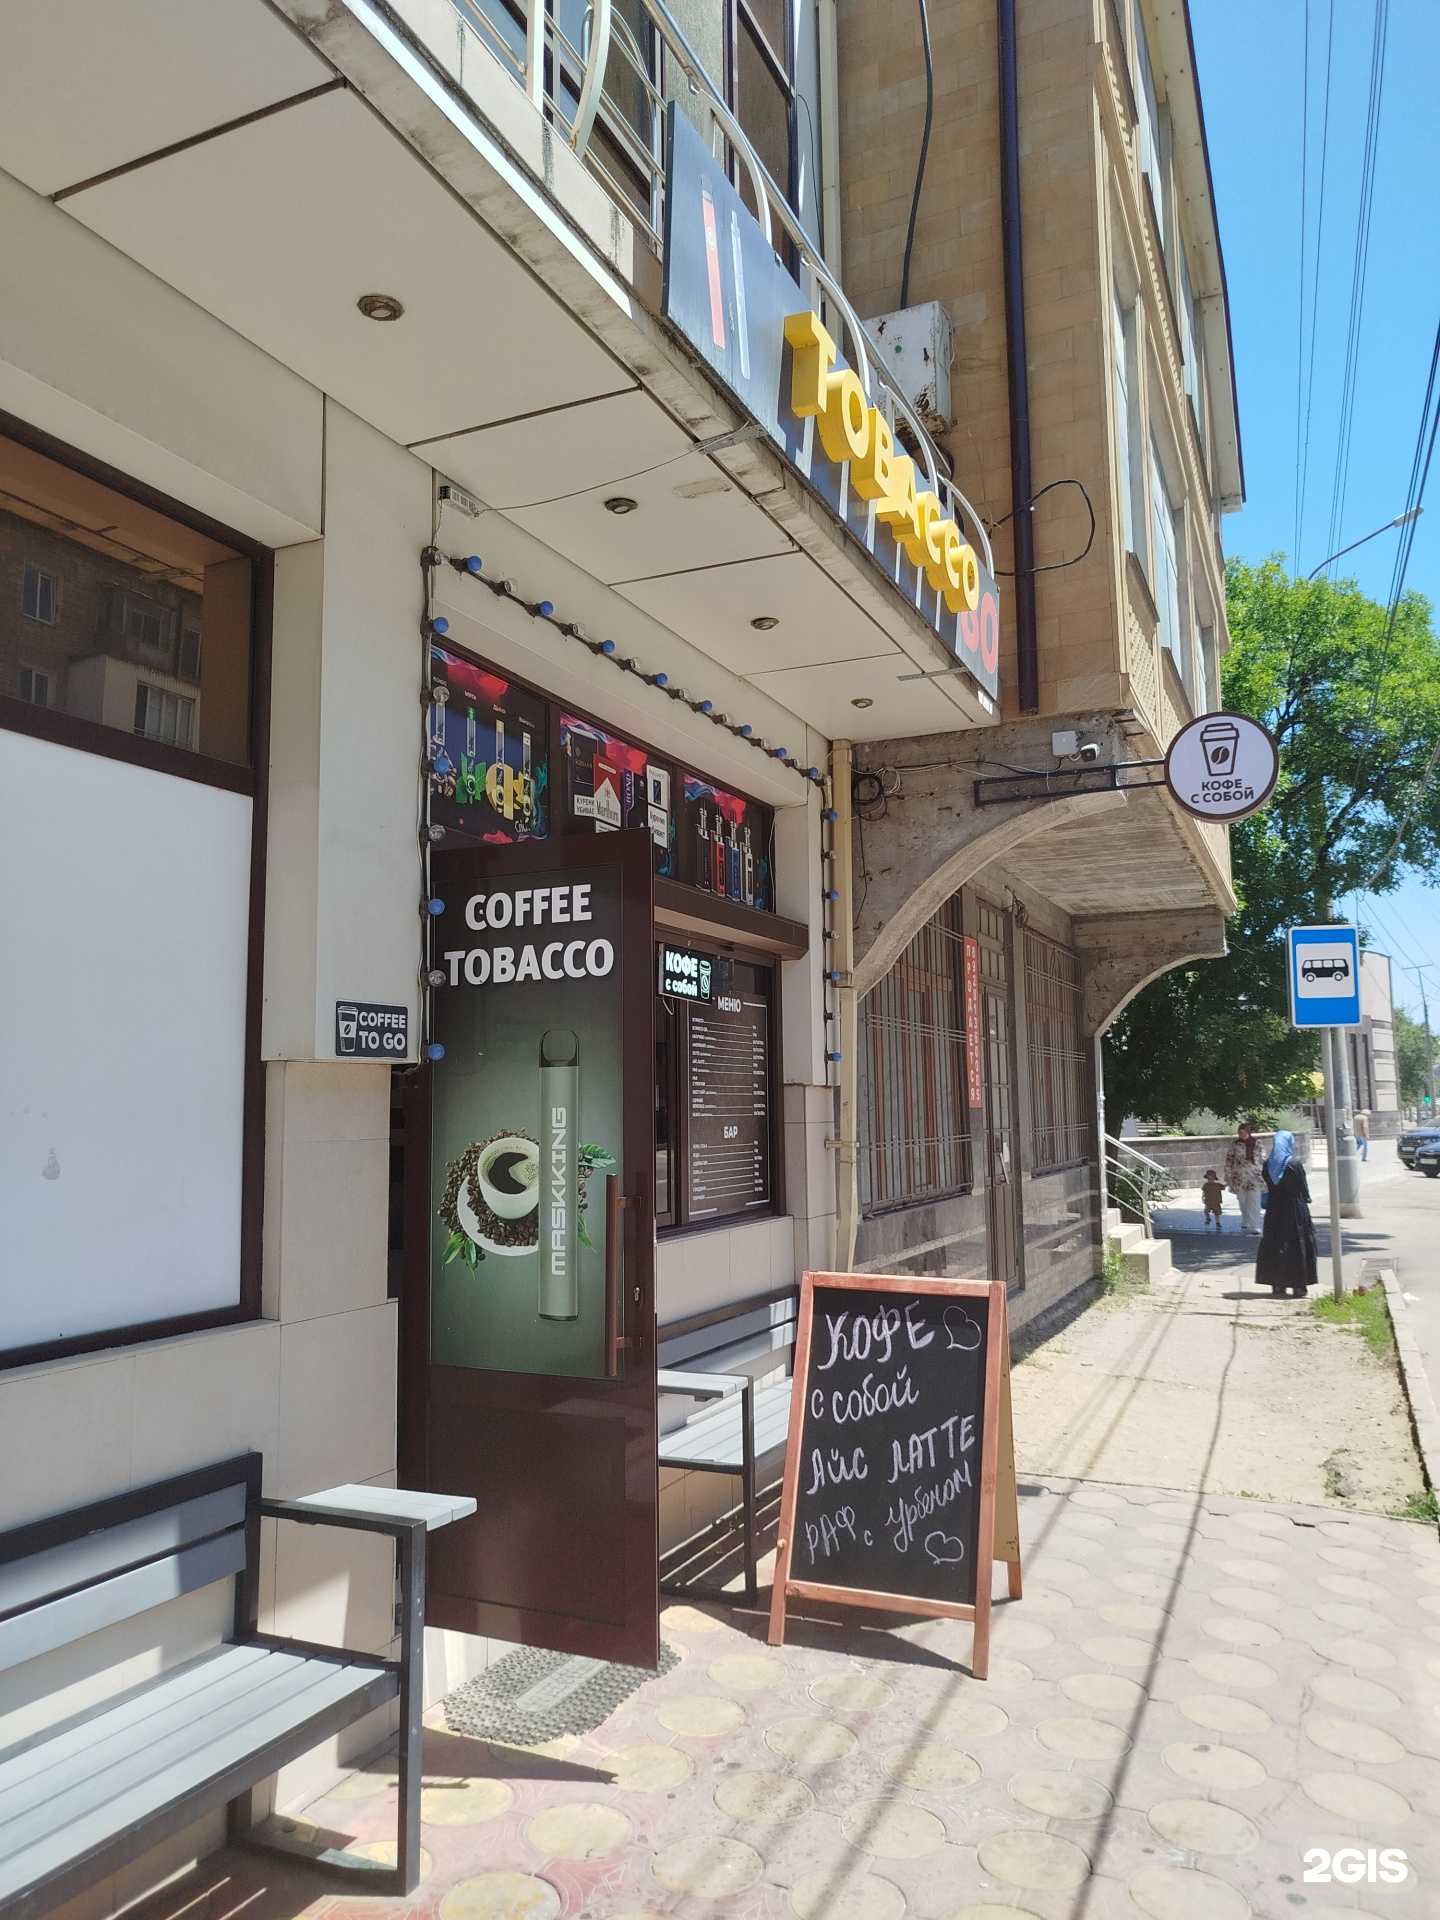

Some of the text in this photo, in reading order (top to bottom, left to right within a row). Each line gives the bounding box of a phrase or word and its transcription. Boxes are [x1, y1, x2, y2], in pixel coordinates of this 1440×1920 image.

[784, 311, 979, 614] TOBACCO
[625, 772, 633, 804] BOND
[1190, 786, 1254, 804] С СОБОЙ
[1201, 779, 1243, 792] КОФЕ
[465, 883, 592, 931] COFFEE
[444, 938, 615, 987] TOBACCO
[665, 951, 699, 978] КОФЕ
[665, 978, 698, 997] с собой
[717, 996, 742, 1014] МЕНЮ
[358, 1011, 406, 1029] COFFEE
[358, 1030, 406, 1051] TO GO
[723, 1125, 738, 1139] БАР
[551, 1107, 567, 1276] MASKKING
[816, 1299, 935, 1370] КОФЕ
[832, 1365, 920, 1424] собой
[888, 1413, 977, 1484] ЛАТТЕ
